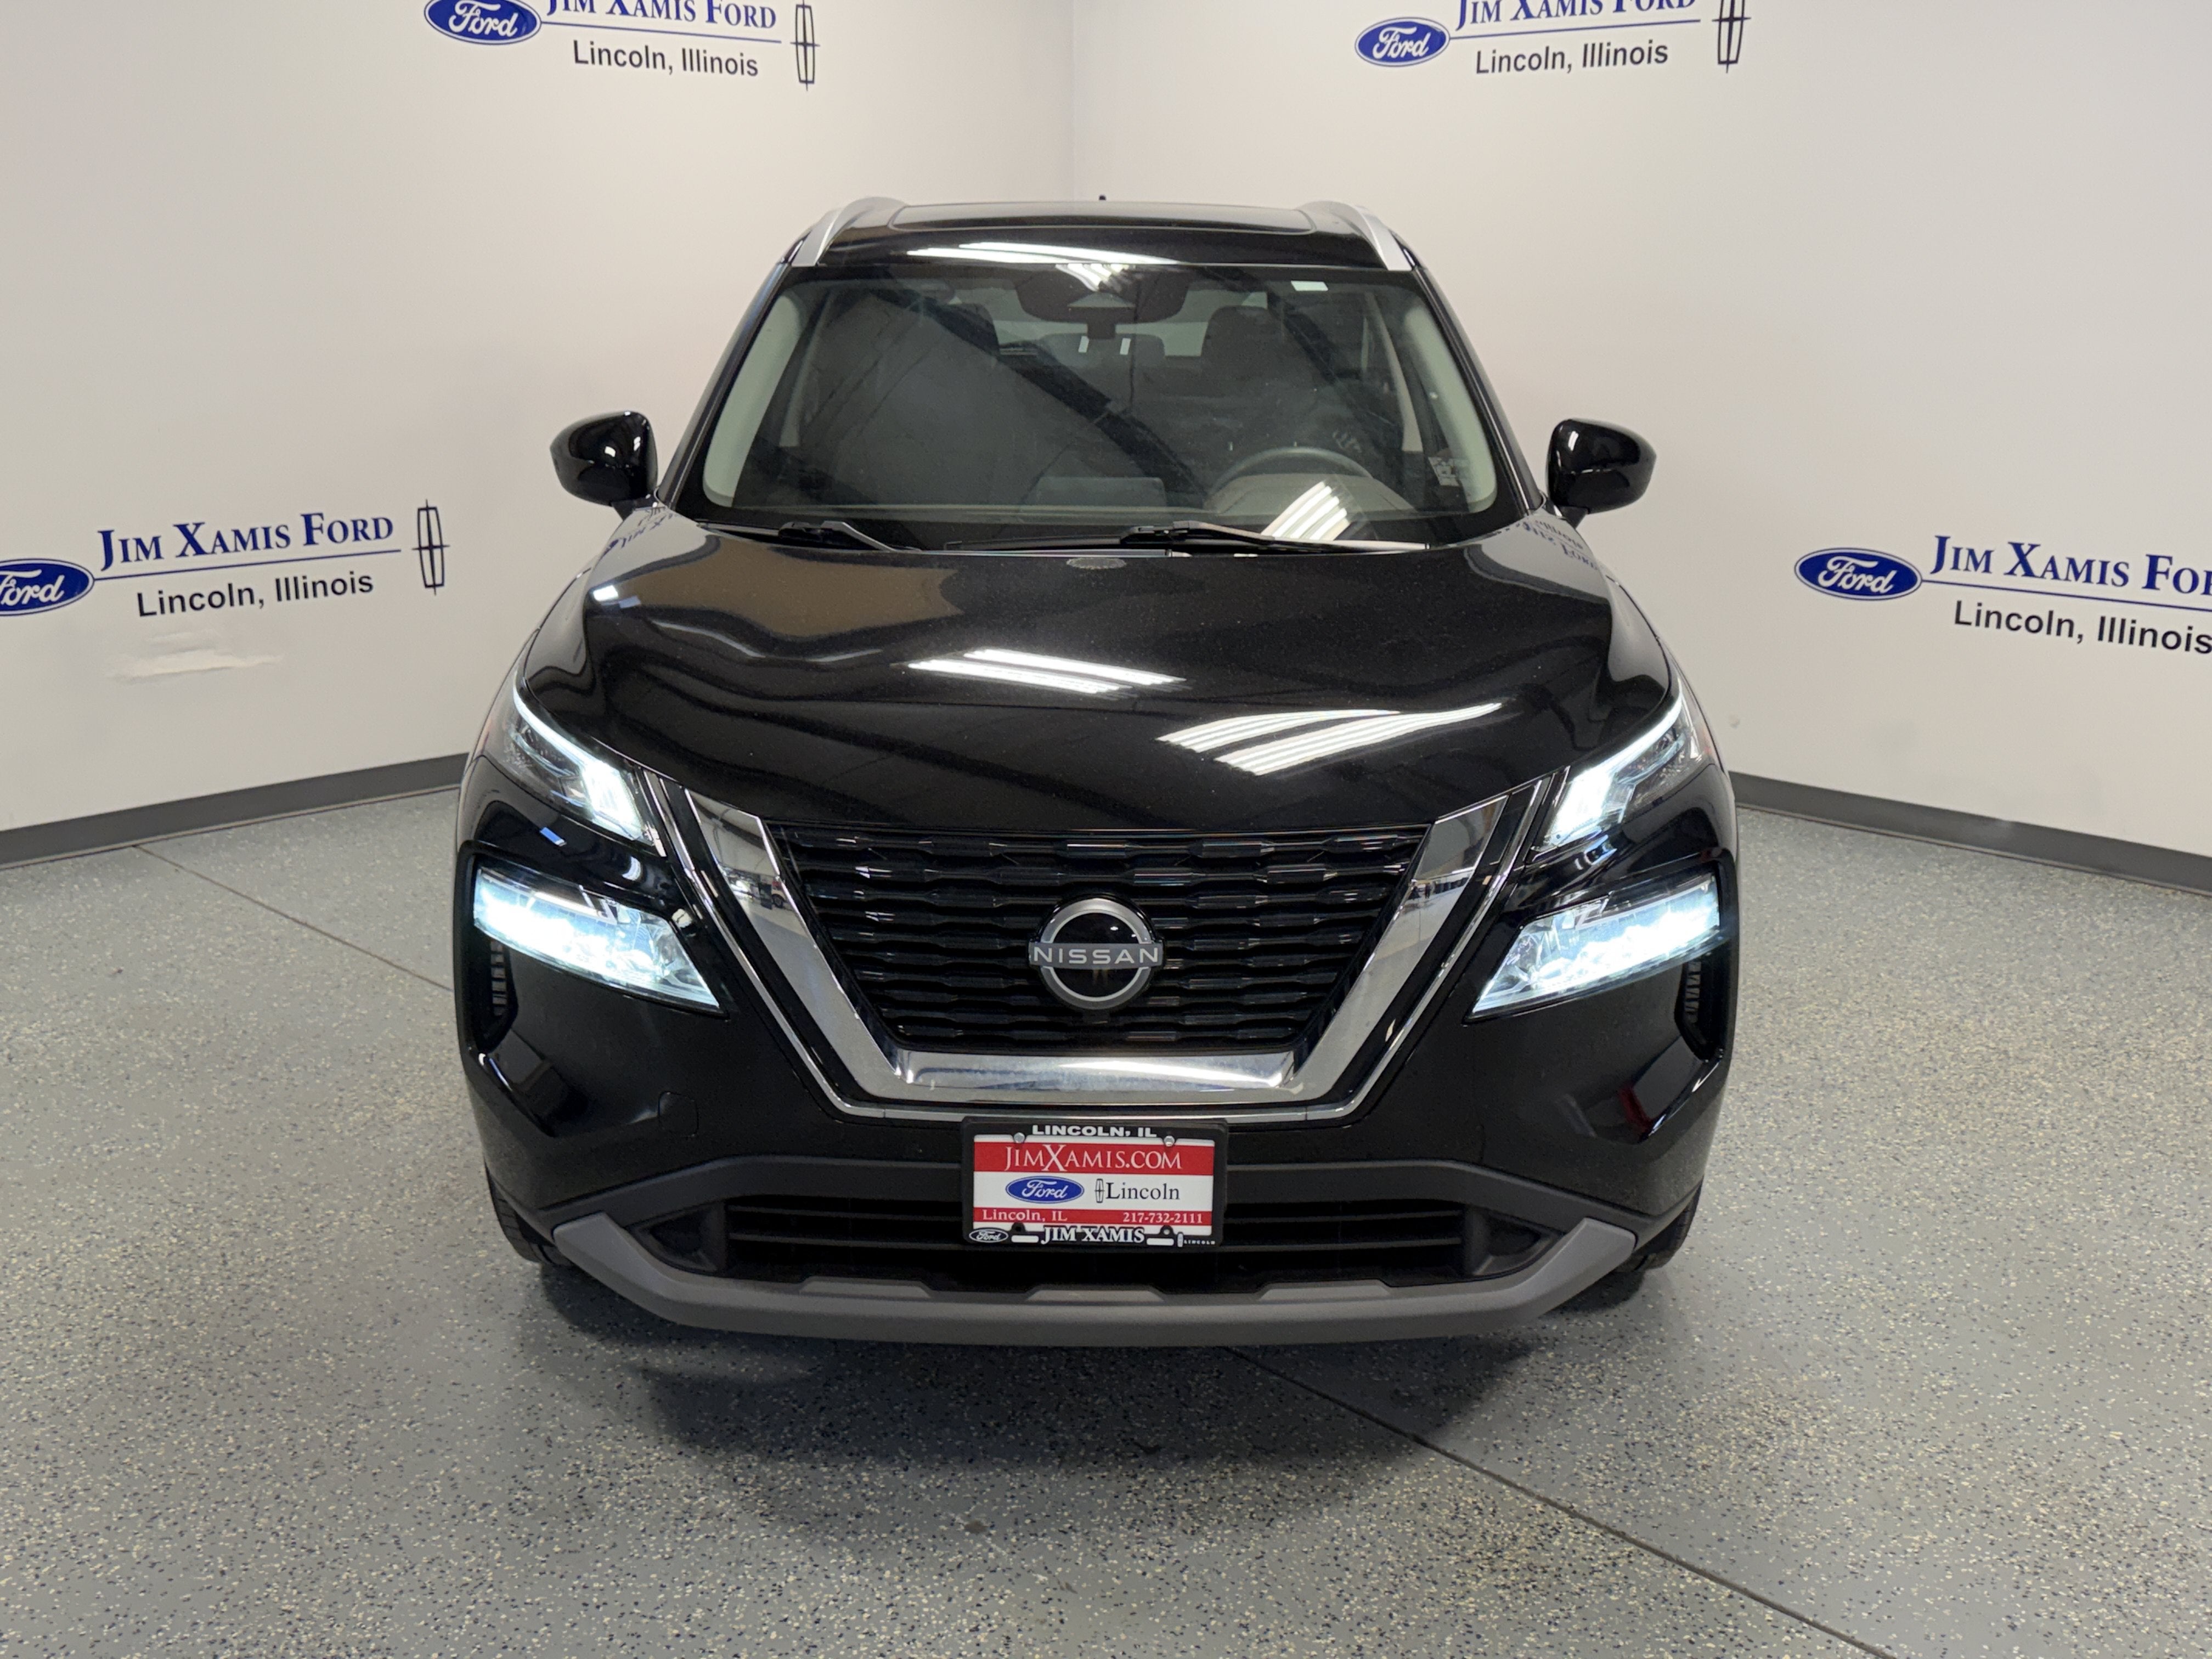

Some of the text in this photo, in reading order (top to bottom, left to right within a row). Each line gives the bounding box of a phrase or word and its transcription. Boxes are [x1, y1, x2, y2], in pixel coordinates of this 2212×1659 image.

[448, 0, 518, 37] Ford
[706, 0, 776, 29] FORD
[1455, 0, 1503, 31] JIM
[573, 40, 759, 76] Lincoln, Illinois
[1373, 27, 1430, 59] Ford
[1476, 40, 1668, 74] Lincoln, Illinois
[97, 512, 393, 571] JIM XAMIS FORD
[1818, 556, 1897, 594] Ford
[1930, 535, 1994, 574] JIM
[2004, 541, 2130, 588] XAMIS
[137, 571, 374, 617] Lincoln, Illinois
[1954, 600, 2212, 654] Lincoln, Illinois
[1034, 947, 1158, 964] NISSAN
[1032, 1125, 1157, 1137] LINCOLN, IL
[1004, 1144, 1182, 1172] JIMXAMIS.COM
[1021, 1180, 1068, 1199] Ford
[1106, 1182, 1180, 1200] Lincoln
[1052, 1211, 1068, 1221] IL
[1122, 1212, 1203, 1224] 217-732-2111
[976, 1230, 1001, 1241] Ford
[1041, 1226, 1145, 1244] JIM XAMIS
